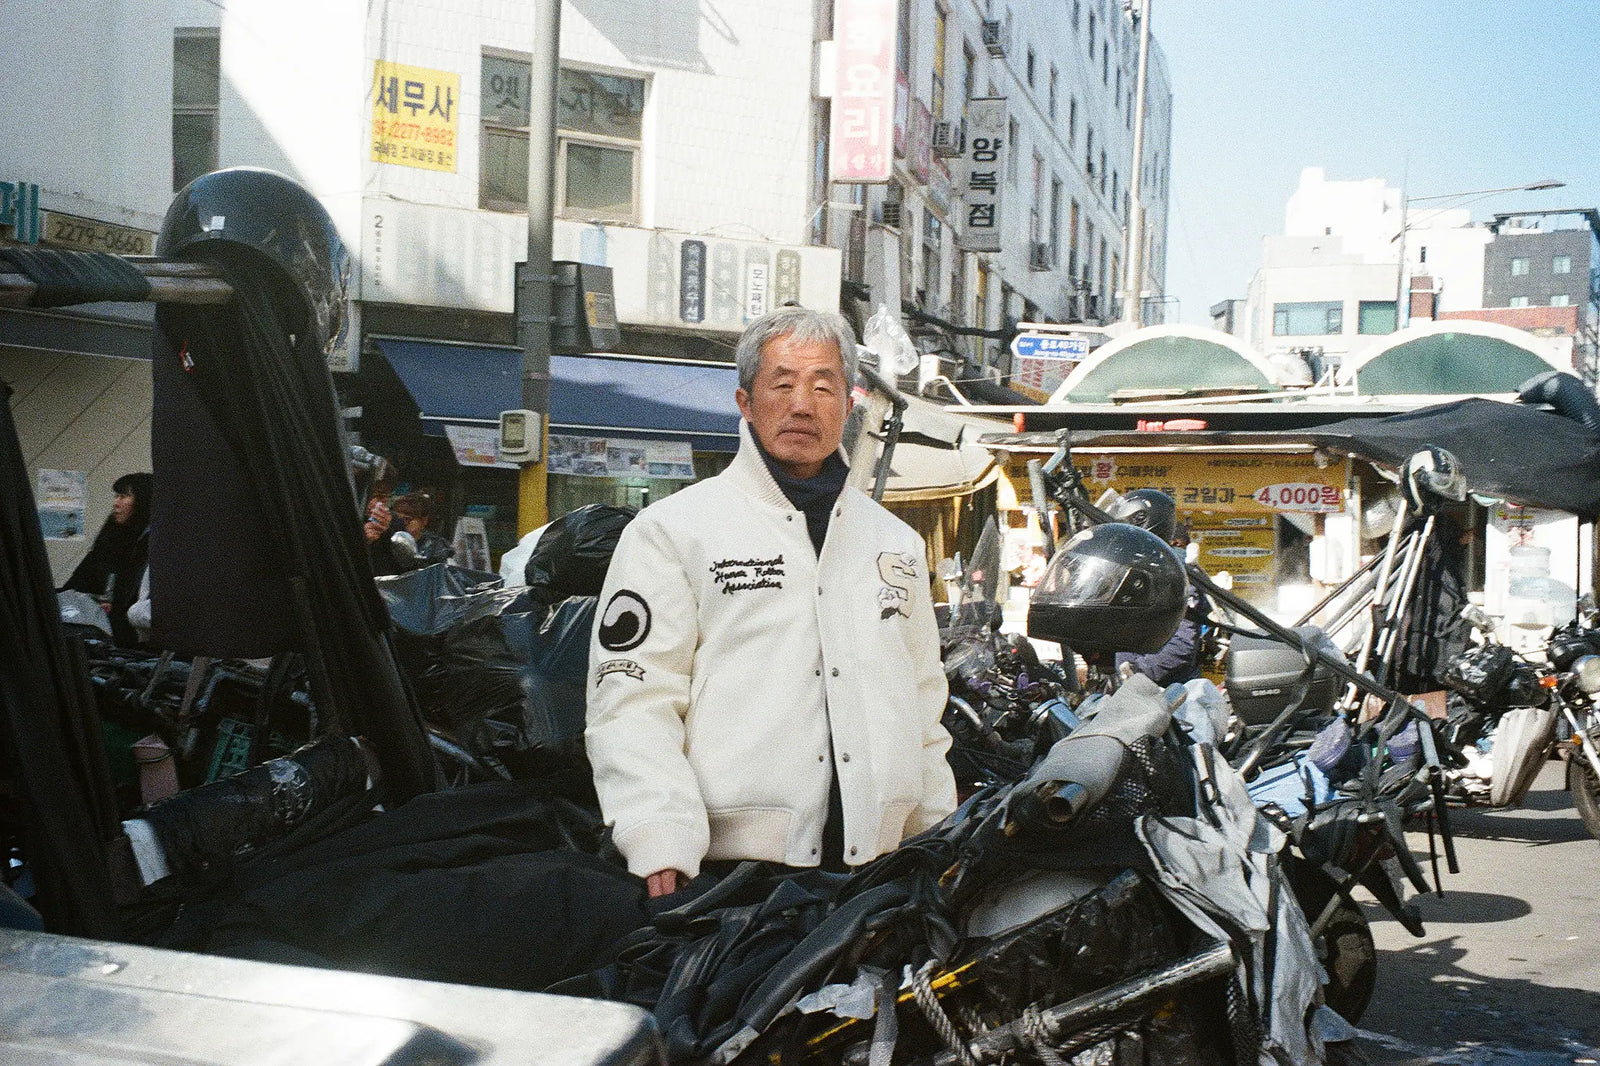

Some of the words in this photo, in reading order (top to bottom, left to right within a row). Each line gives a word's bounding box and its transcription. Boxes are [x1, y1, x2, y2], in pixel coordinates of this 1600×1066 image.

[376, 75, 453, 122] 세무사
[969, 137, 1002, 228] 양복점
[55, 220, 145, 254] 2279-0660
[1183, 487, 1236, 504] 균일가
[1258, 486, 1340, 507] 4,000원
[709, 554, 784, 572] International
[722, 578, 783, 595] Association
